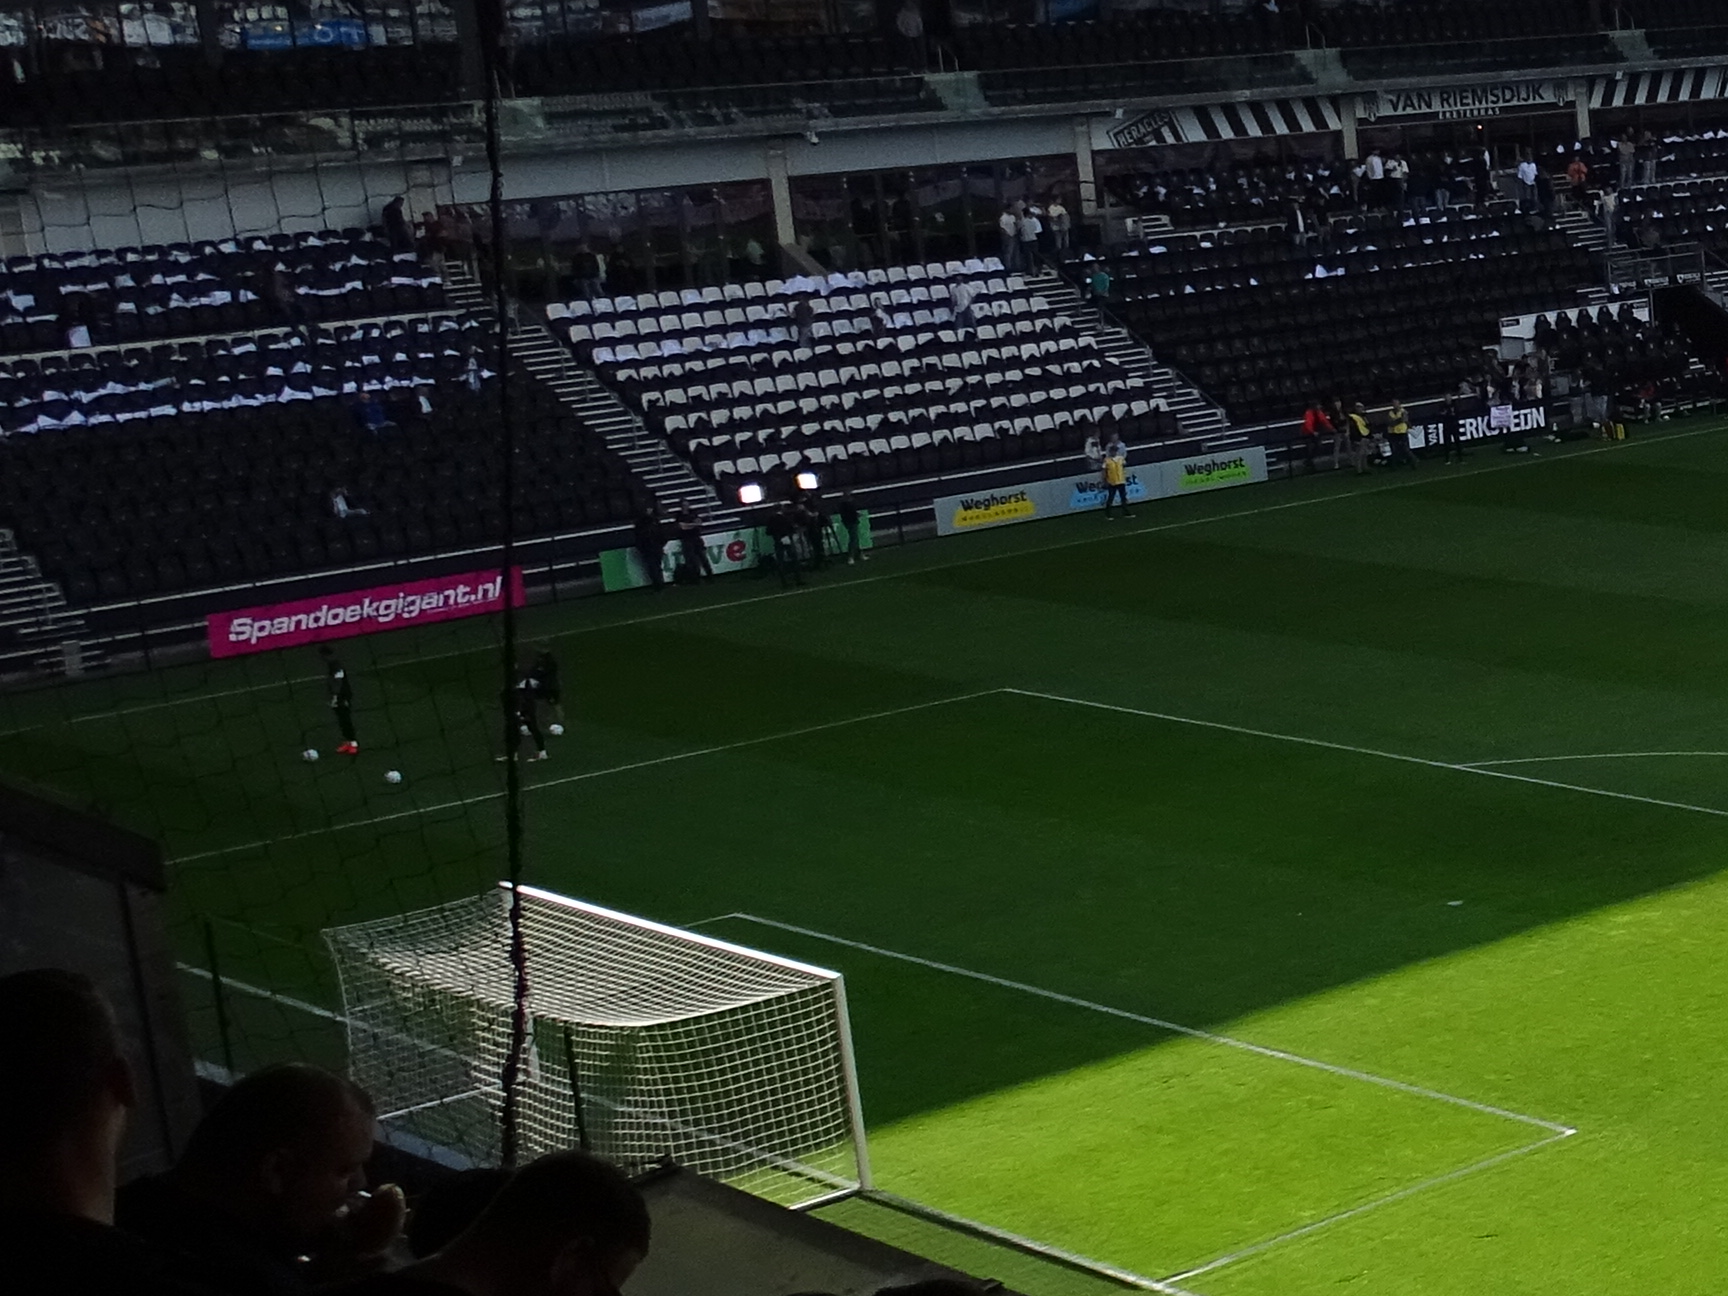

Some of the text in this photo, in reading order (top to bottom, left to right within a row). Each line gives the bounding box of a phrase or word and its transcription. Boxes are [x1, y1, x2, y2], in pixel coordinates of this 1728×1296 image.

[1389, 83, 1545, 113] VAN RIEMSDIJK
[1115, 111, 1170, 148] HERACLES
[1184, 456, 1246, 476] Weghorst
[960, 490, 1027, 511] Weghorst
[228, 575, 503, 645] Spandoekgigant.nl
